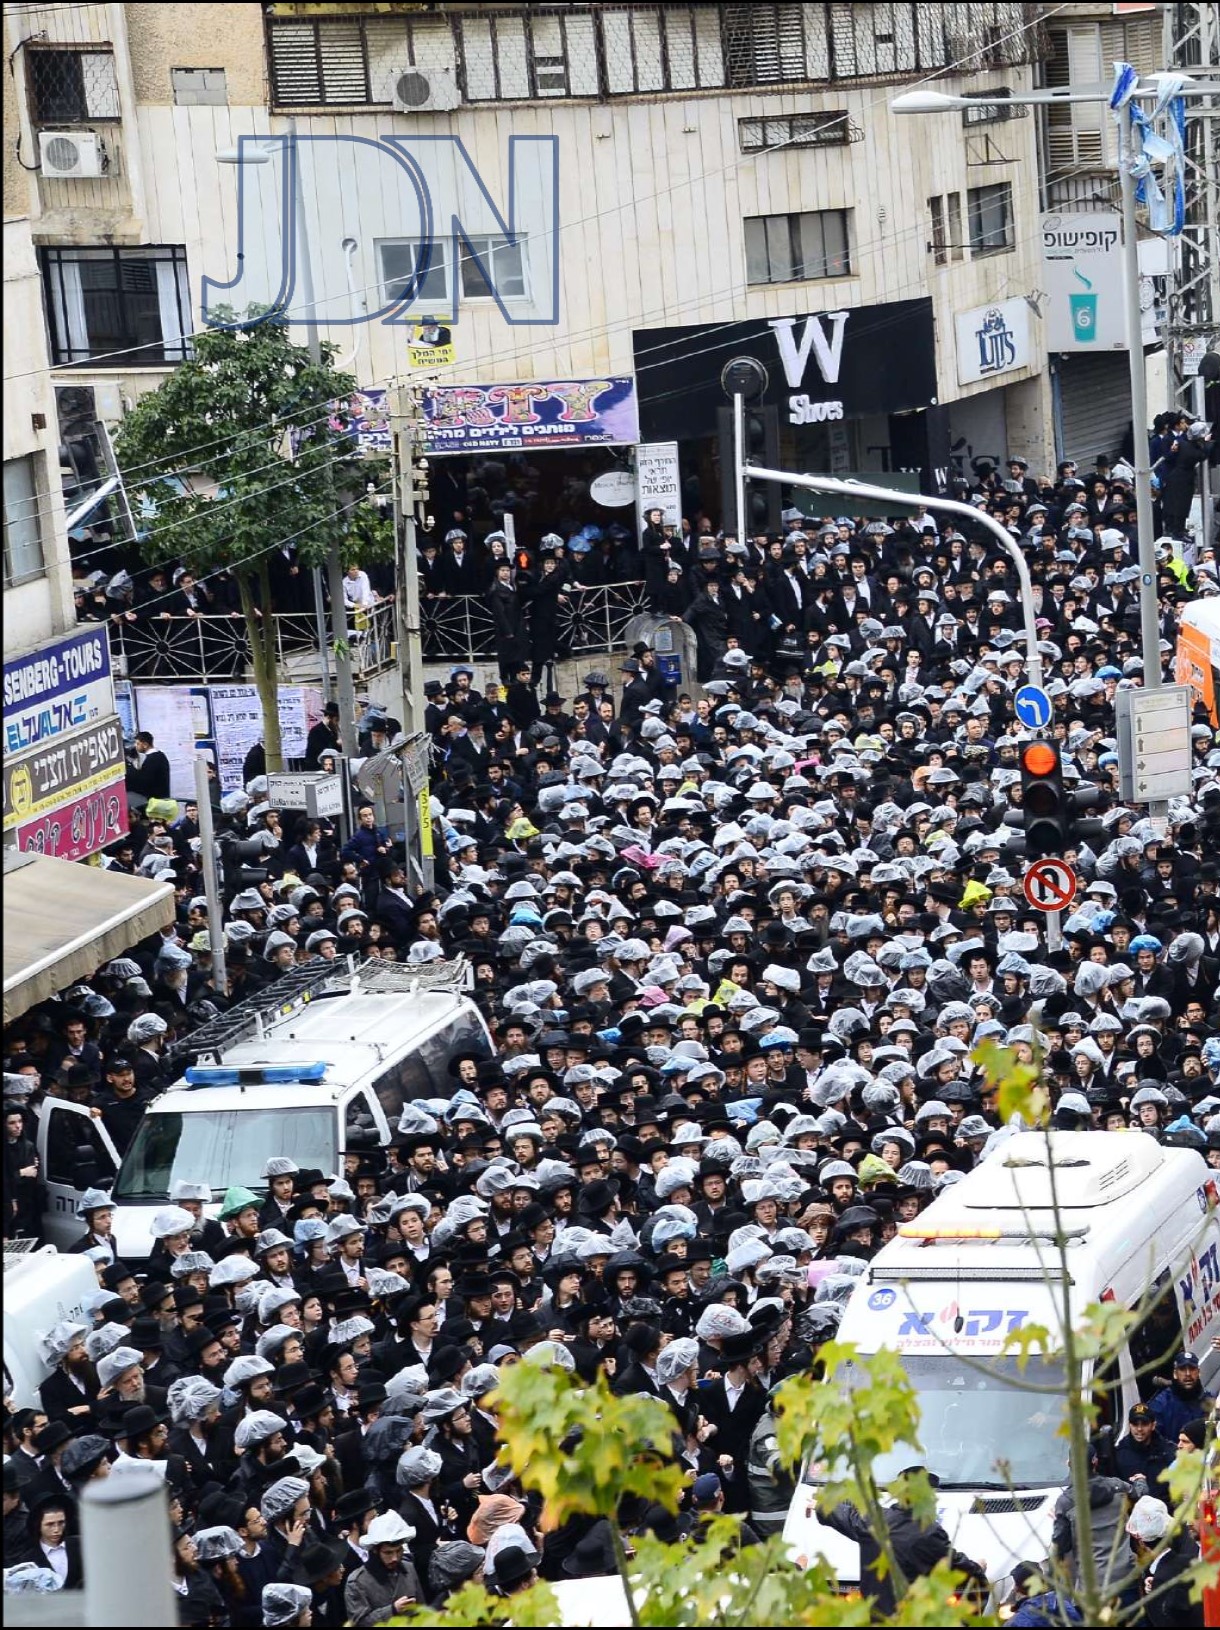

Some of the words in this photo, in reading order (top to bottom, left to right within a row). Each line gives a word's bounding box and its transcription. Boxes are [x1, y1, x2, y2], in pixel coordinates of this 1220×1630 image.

[1044, 230, 1117, 252] קופישופ
[411, 349, 436, 360] המלך
[768, 311, 849, 388] W
[789, 394, 843, 425] Shoes
[469, 425, 519, 438] לילדים
[642, 484, 677, 495] תוצאות
[3, 638, 103, 707] SENBERG-TOURS
[70, 726, 119, 777] מאפיית
[872, 1293, 893, 1306] 36
